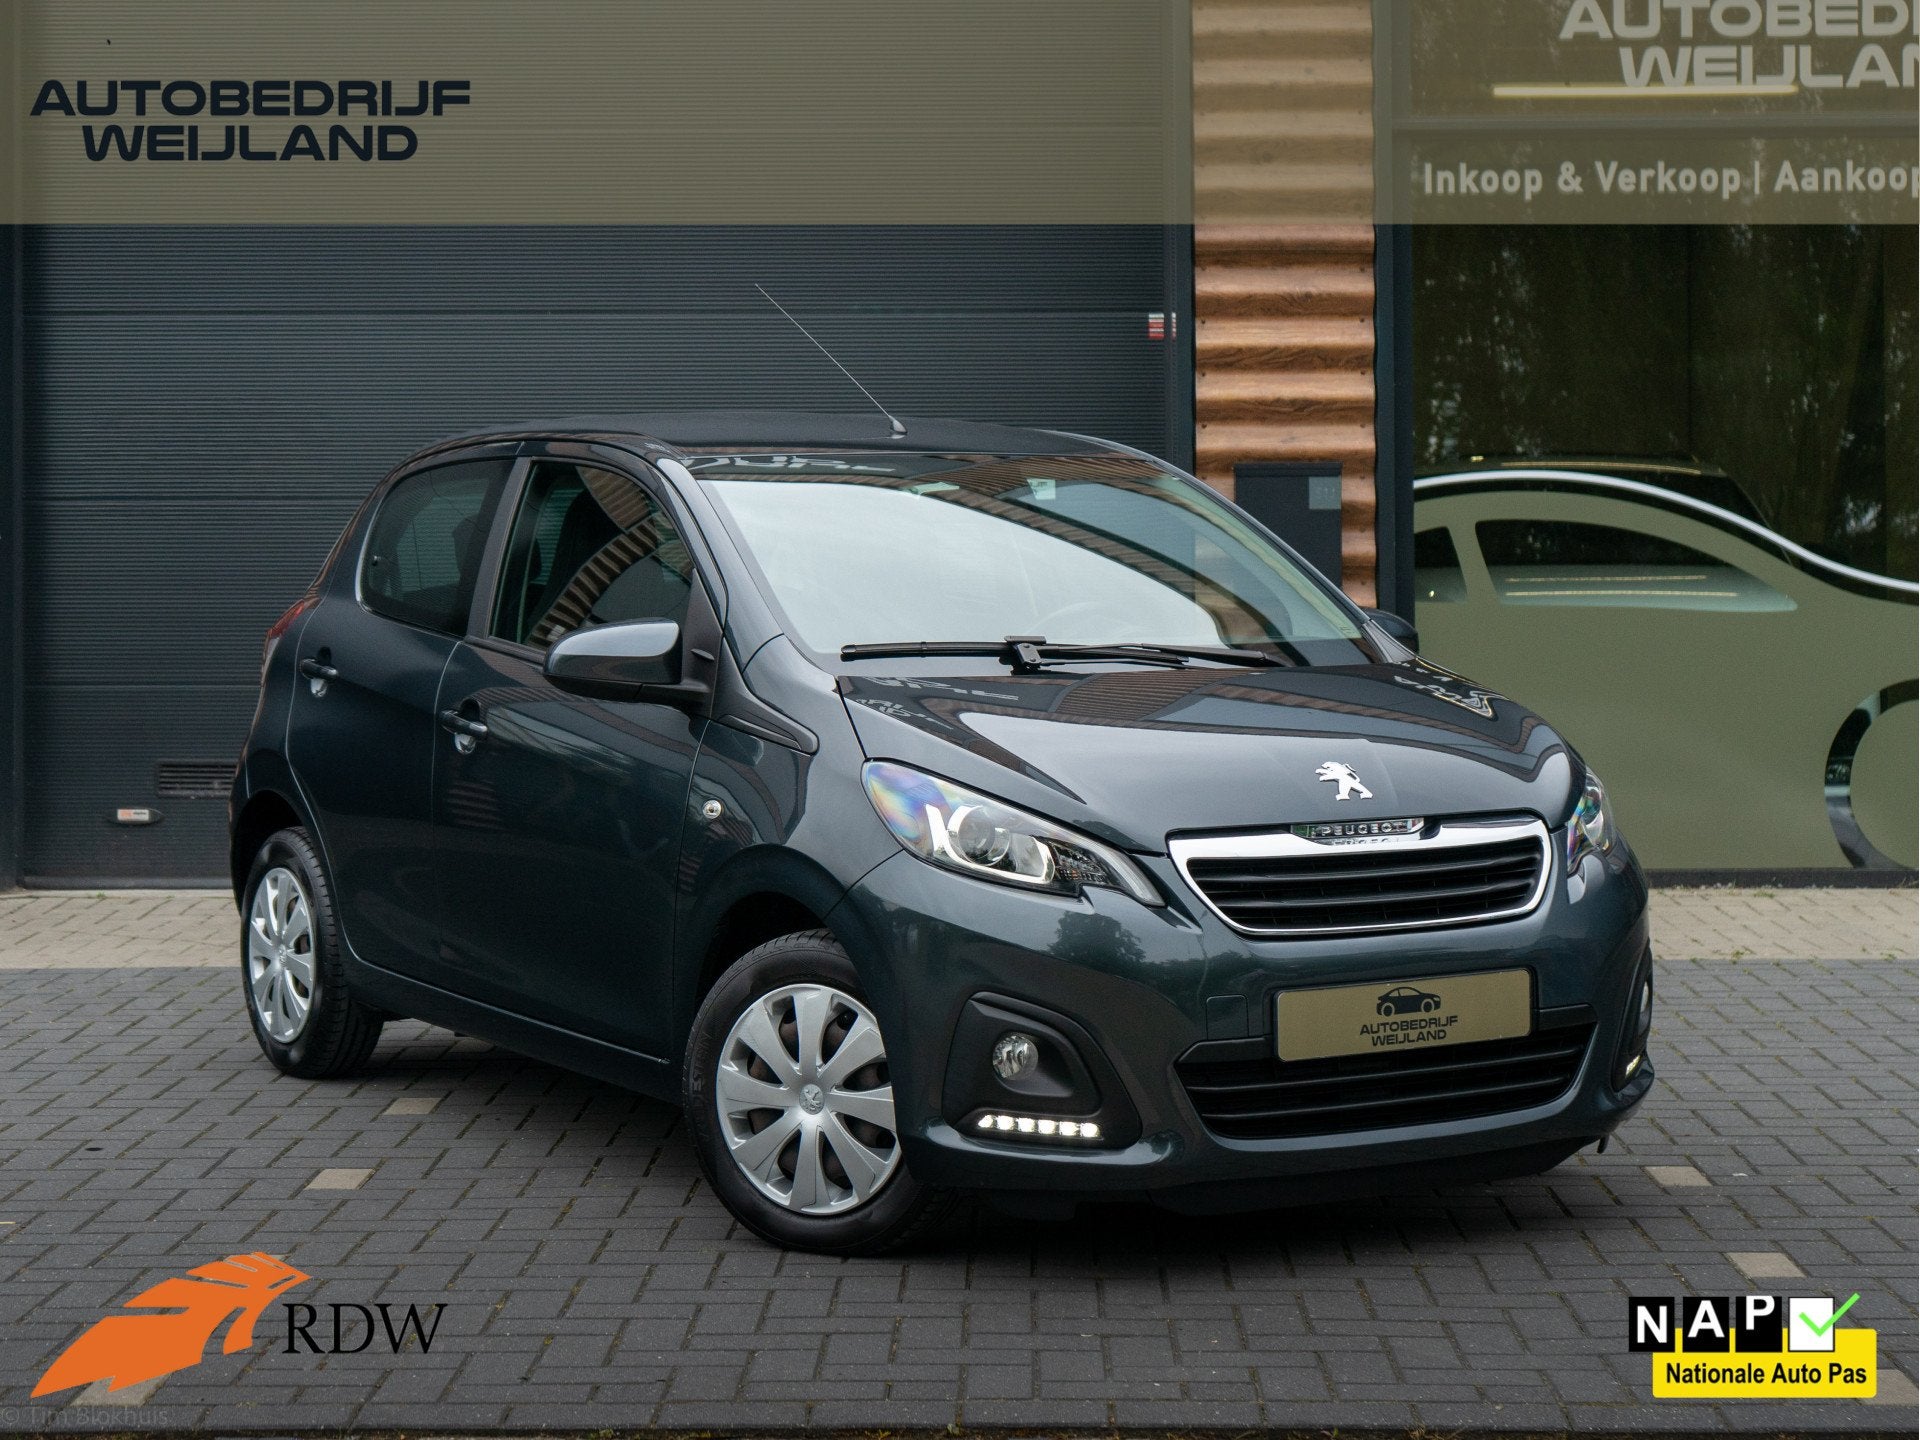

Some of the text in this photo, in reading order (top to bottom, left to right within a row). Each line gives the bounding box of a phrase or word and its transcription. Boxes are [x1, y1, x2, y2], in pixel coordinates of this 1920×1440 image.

[1559, 0, 1919, 39] AUTOBED
[1424, 162, 1543, 199] Inkoop
[1557, 161, 1584, 193] &
[1596, 160, 1741, 199] Verkoop
[1320, 820, 1405, 837] PEUGEOT
[1360, 1015, 1458, 1035] AUTOBEDRIJF
[1371, 1029, 1447, 1047] WEIJLAND
